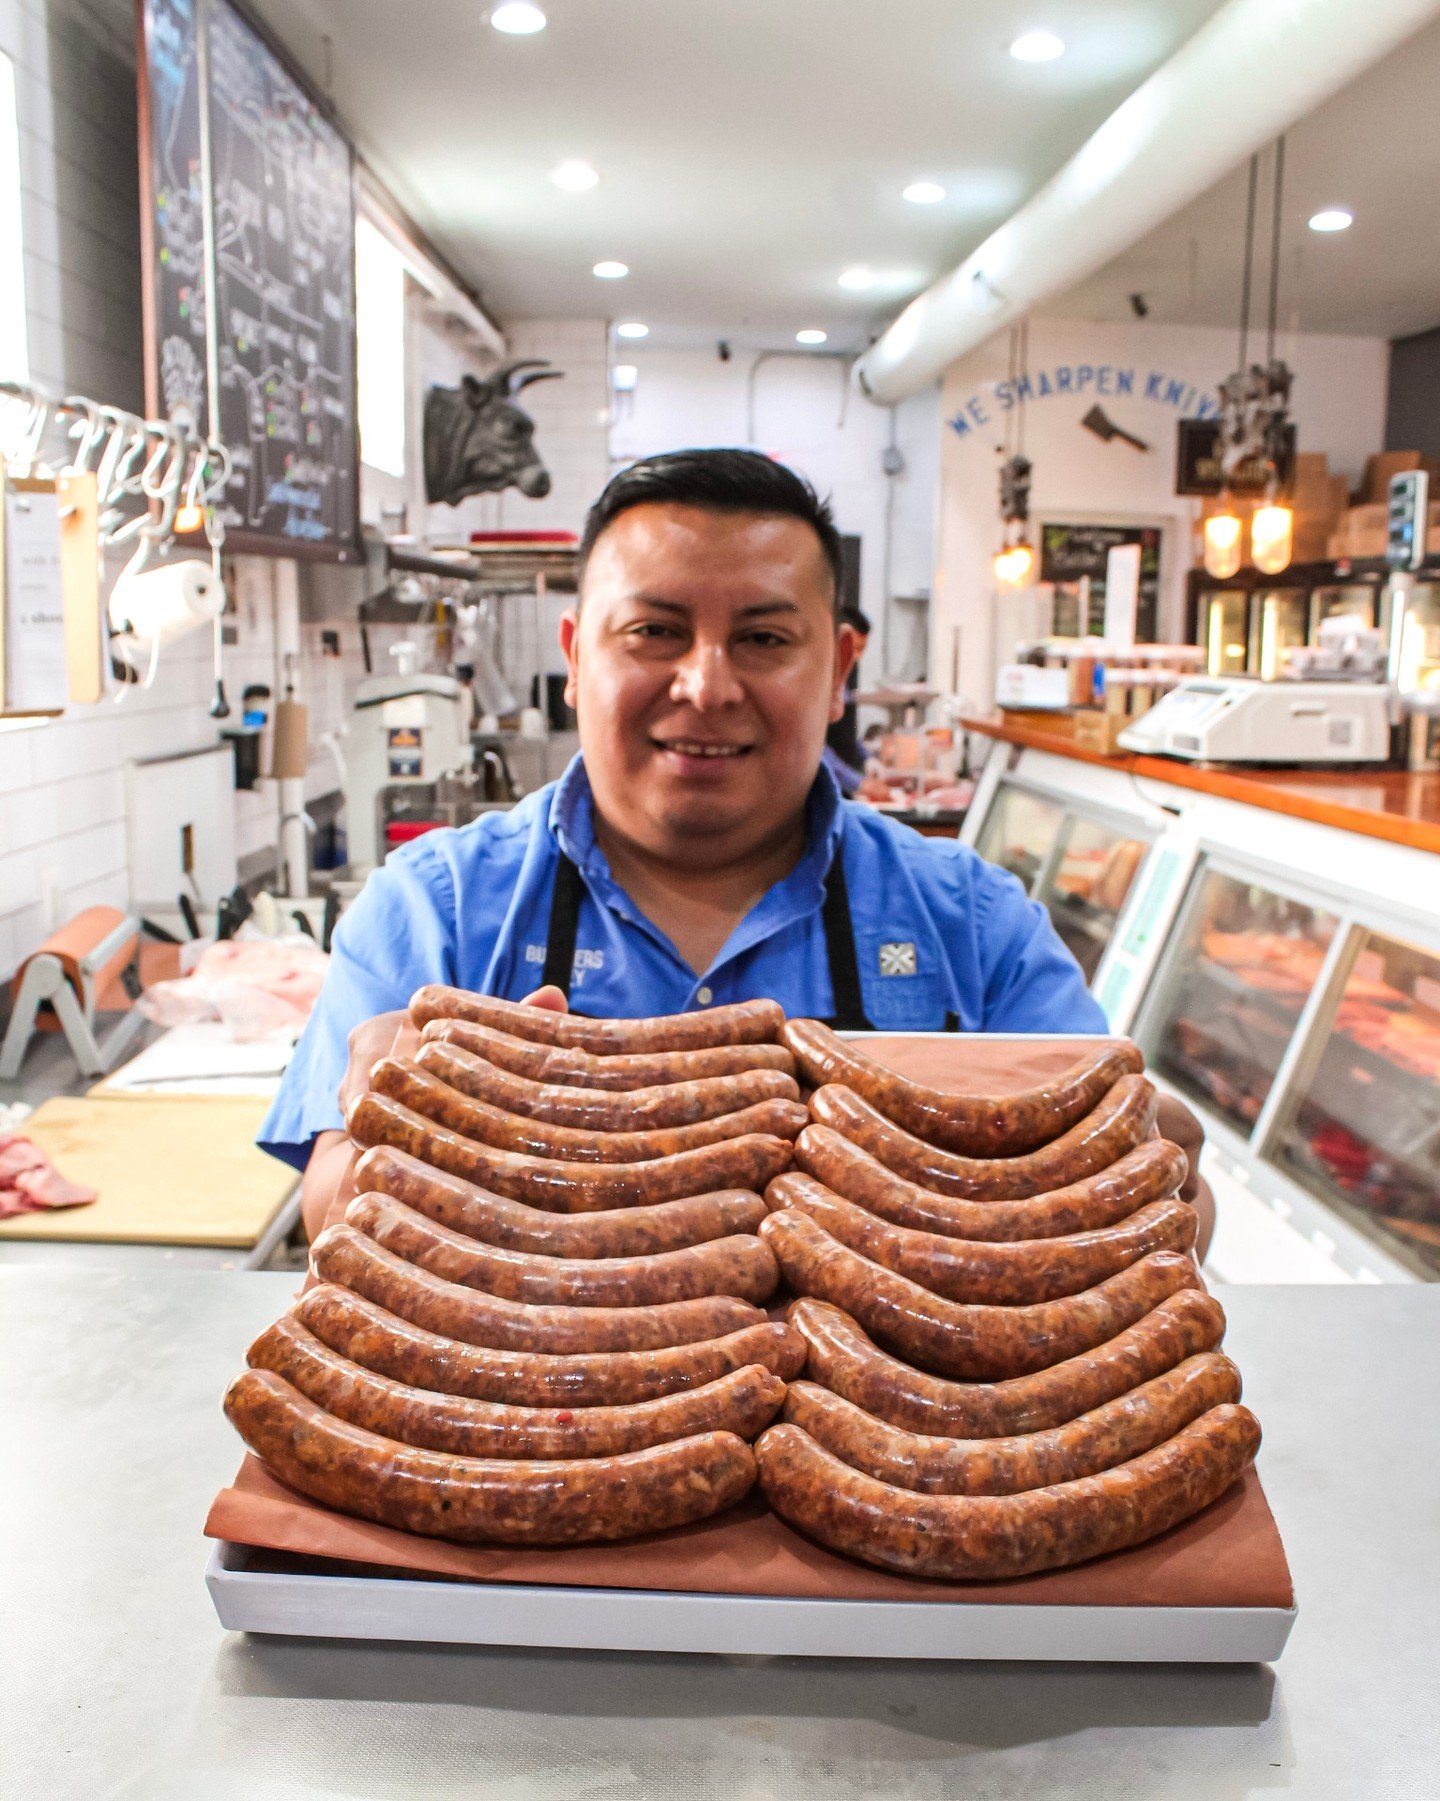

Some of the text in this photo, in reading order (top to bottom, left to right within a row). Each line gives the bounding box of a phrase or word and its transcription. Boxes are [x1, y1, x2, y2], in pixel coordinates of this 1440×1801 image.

[946, 366, 1219, 437] WE SHARPEN KNIV
[525, 944, 604, 970] BUERS
